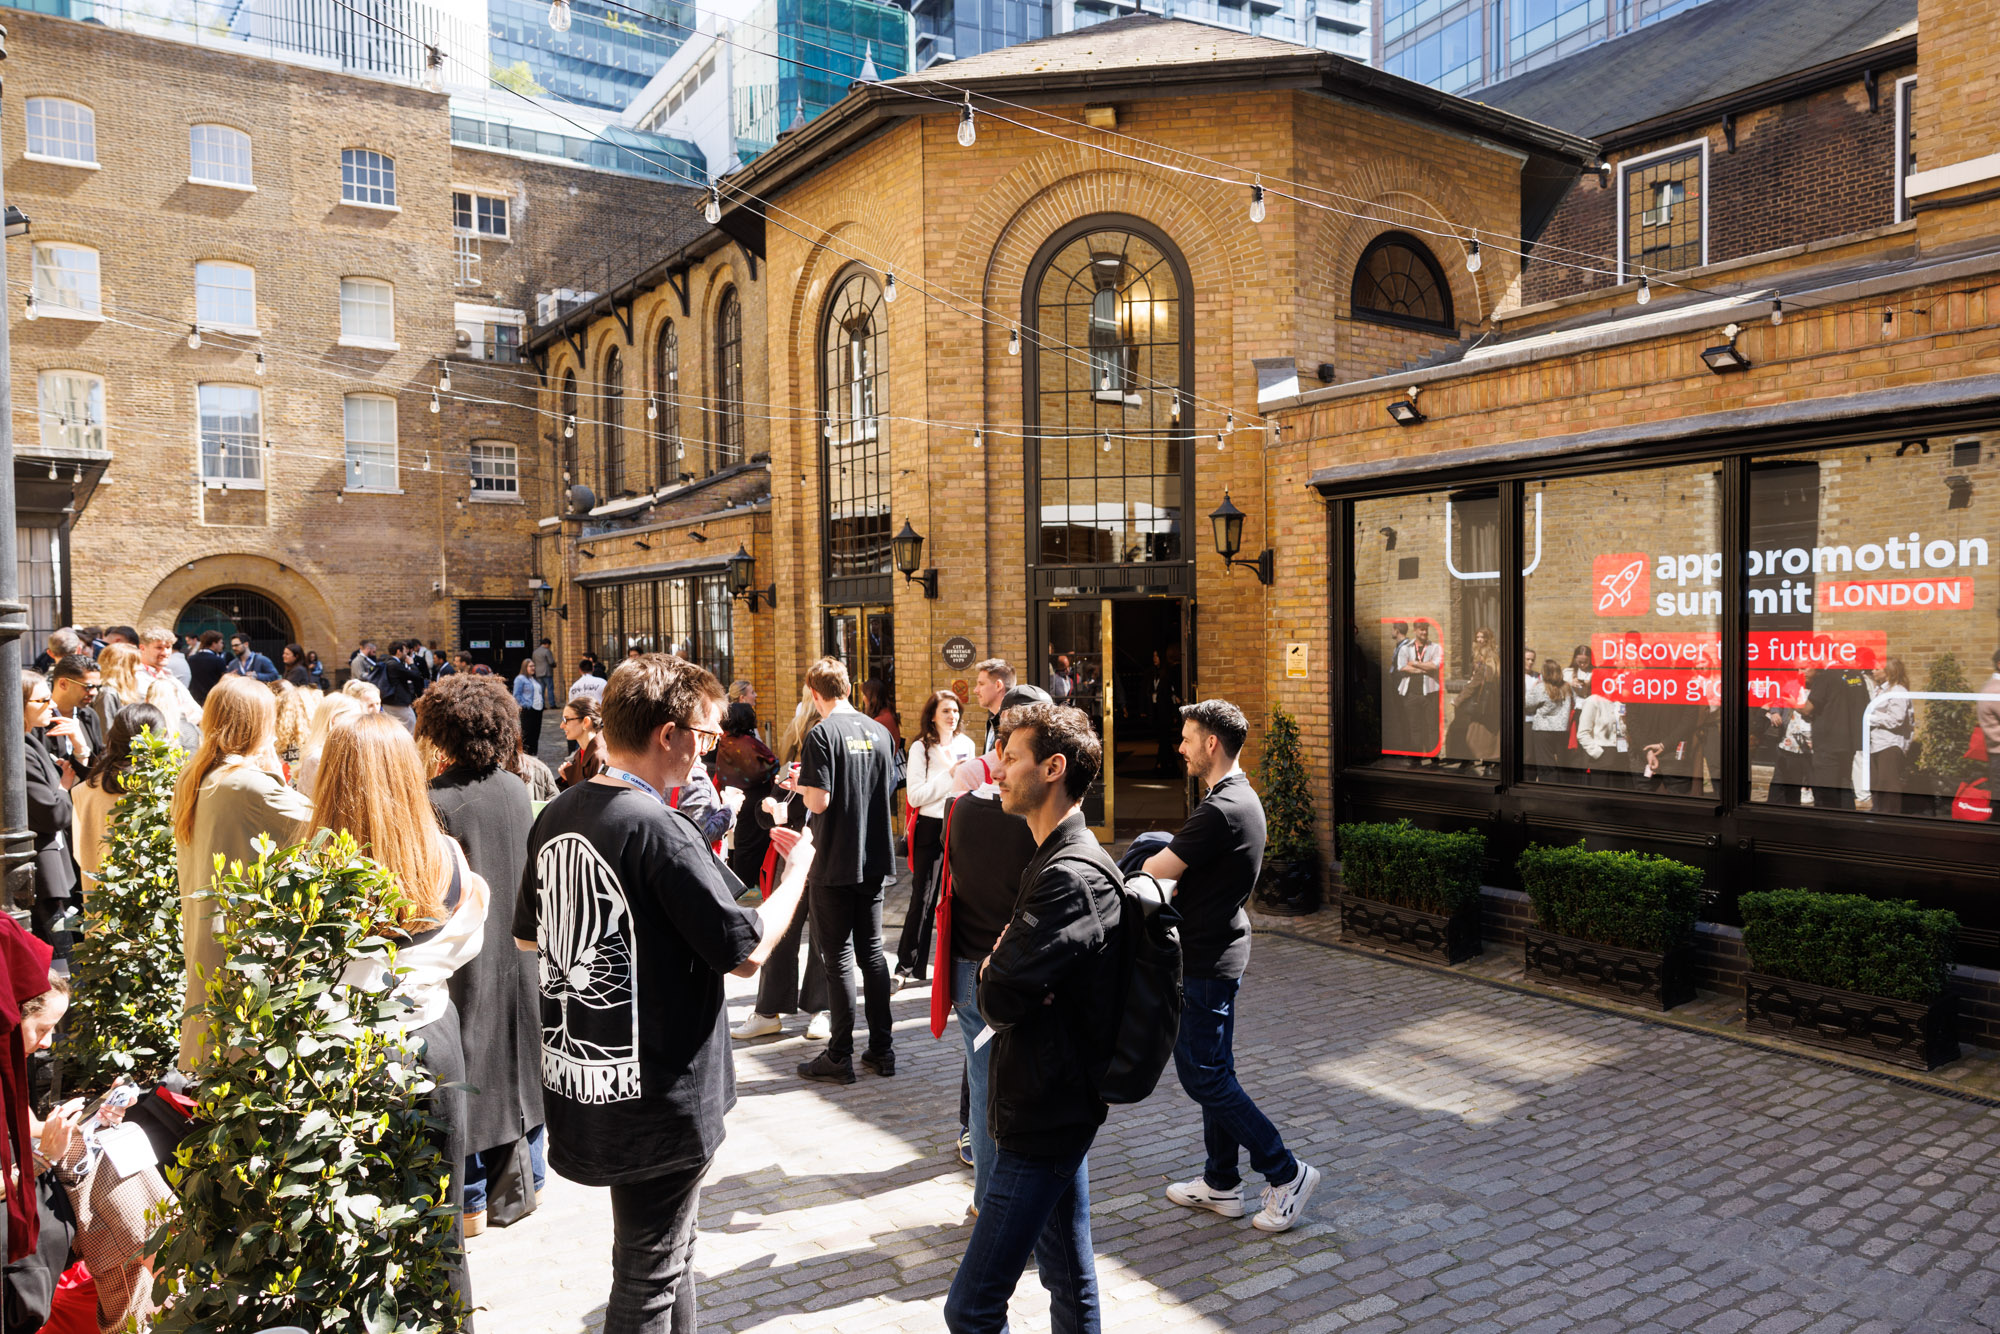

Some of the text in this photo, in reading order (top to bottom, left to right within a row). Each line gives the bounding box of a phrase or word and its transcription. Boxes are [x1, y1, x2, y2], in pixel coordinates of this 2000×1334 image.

[1656, 552, 1722, 586] app
[1829, 582, 1961, 607] LONDON
[1602, 638, 1857, 661] Discover te future
[1602, 674, 1780, 701] of app grth
